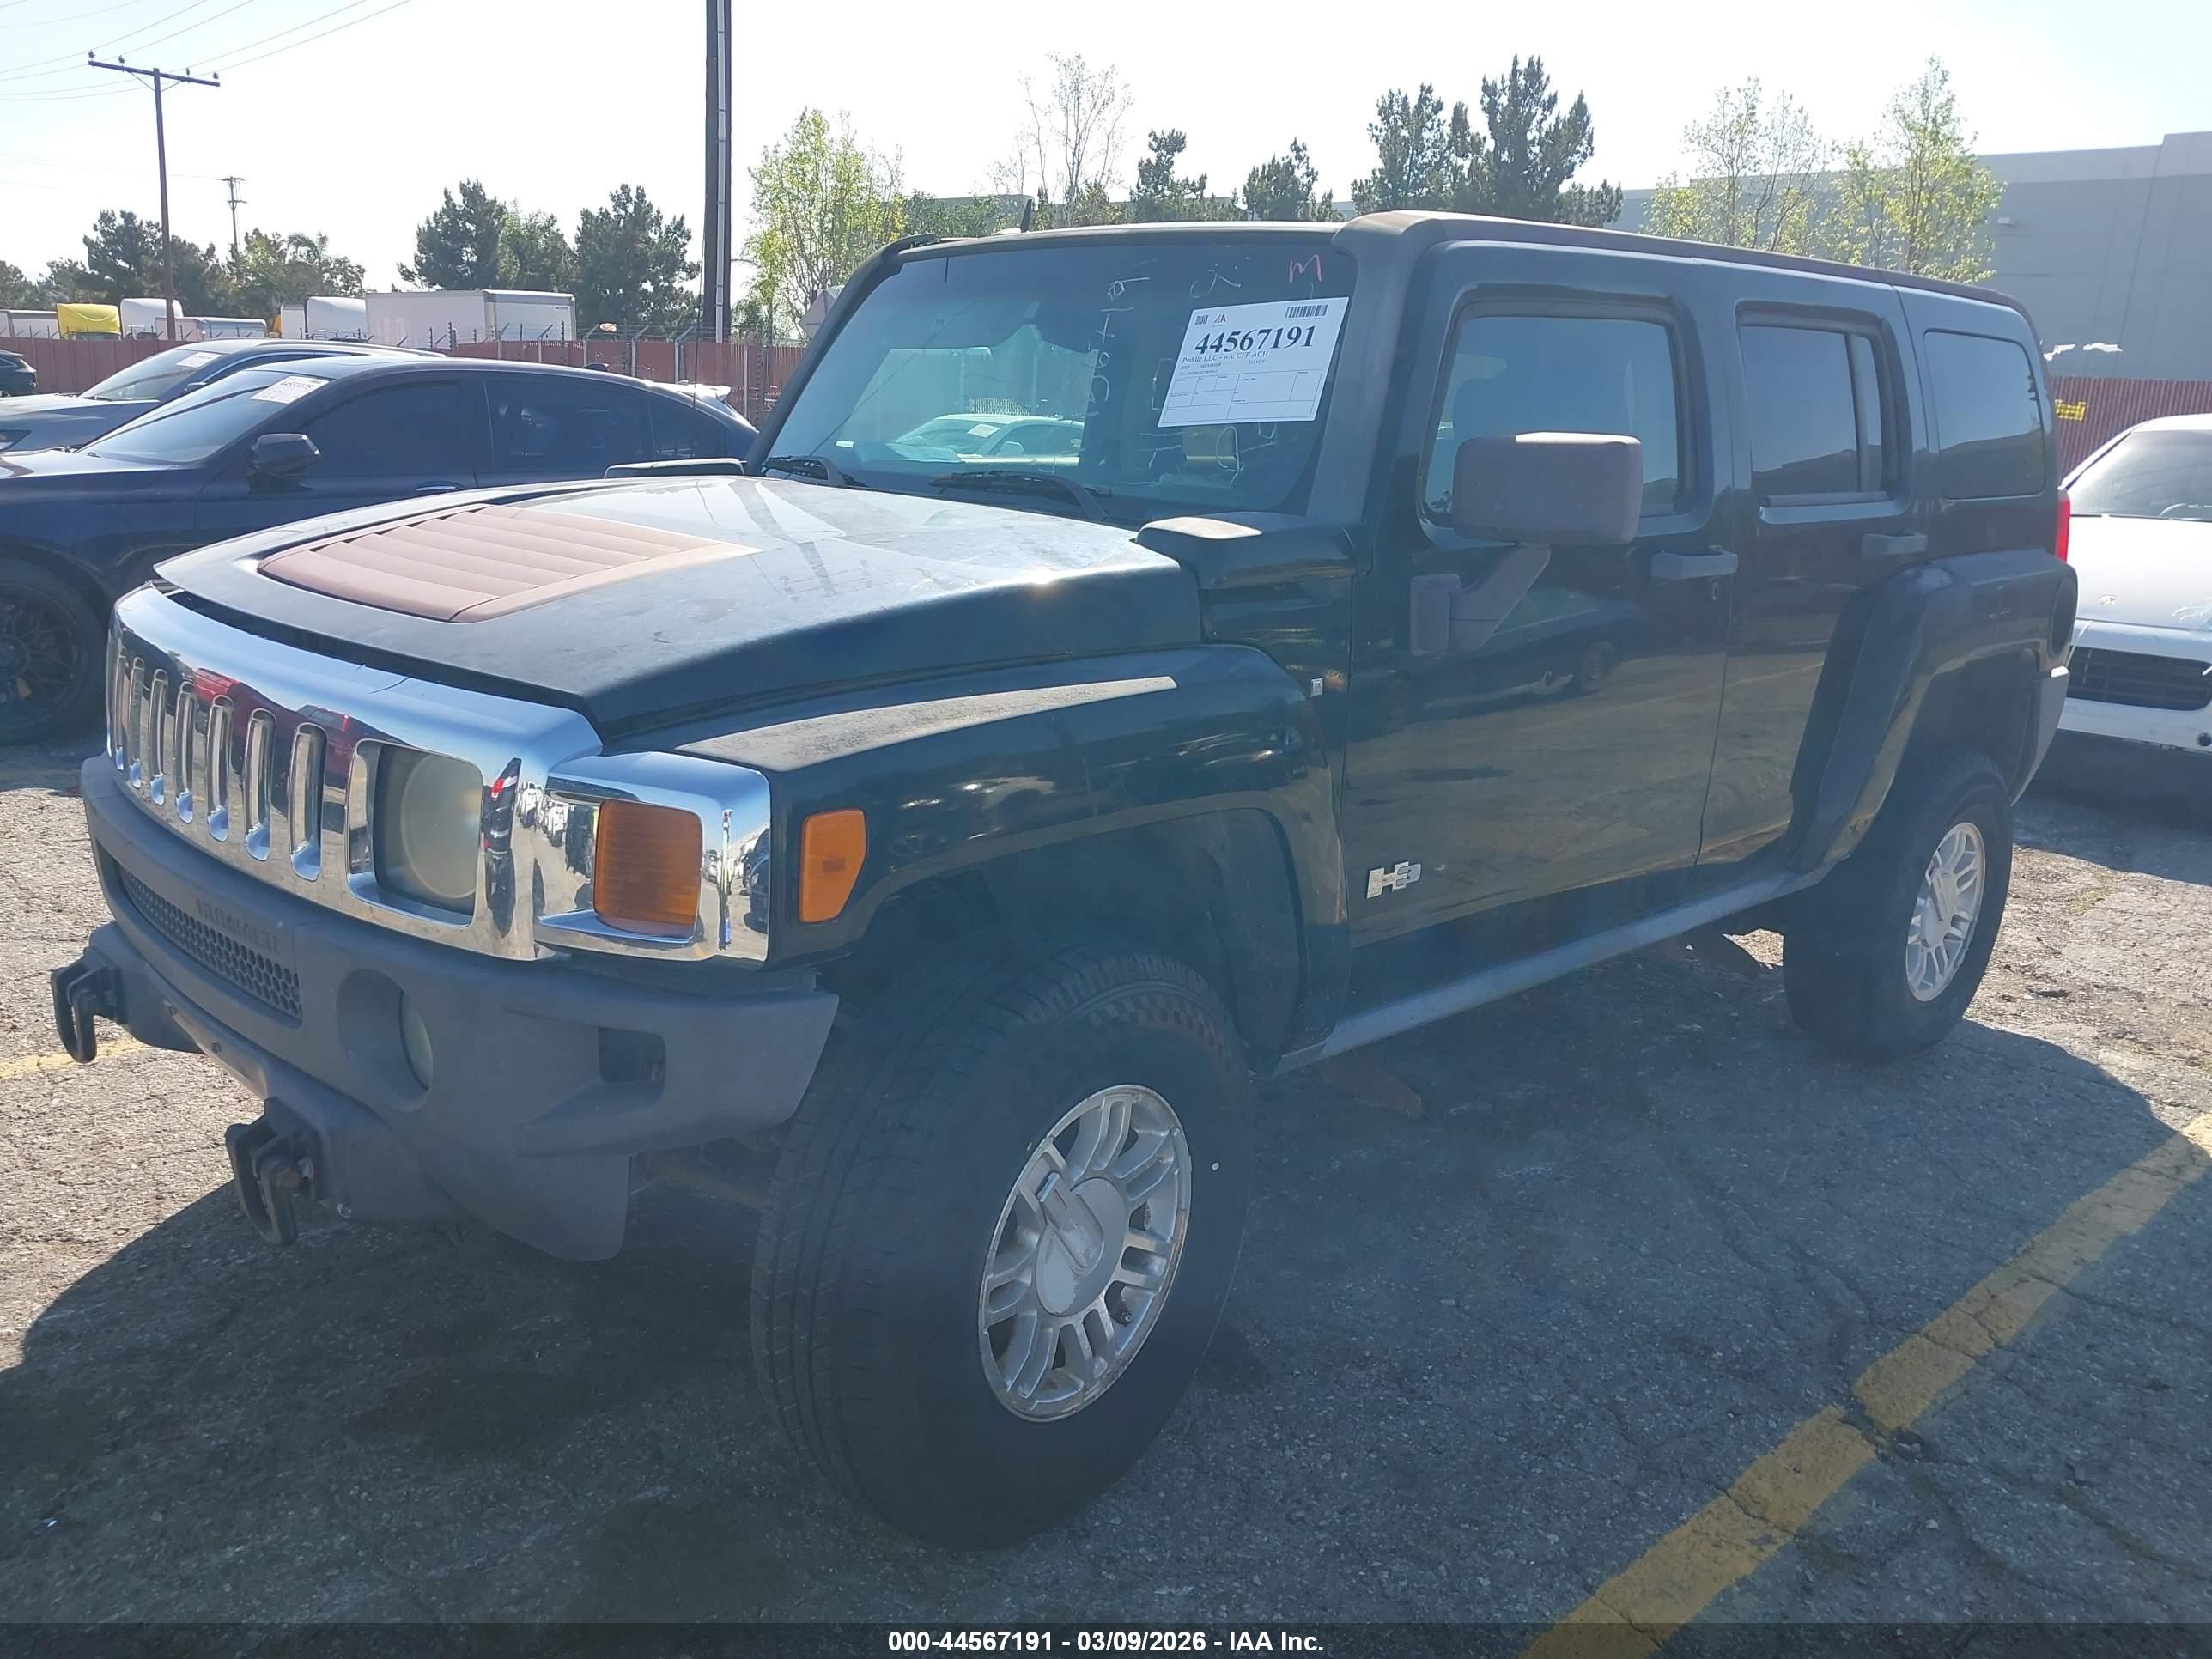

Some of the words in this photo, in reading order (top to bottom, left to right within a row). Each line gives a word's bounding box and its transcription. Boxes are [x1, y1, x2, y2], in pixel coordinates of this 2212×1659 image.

[1195, 325, 1316, 354] 44567191
[1182, 356, 1202, 364] Peddle
[1367, 860, 1422, 899] H3
